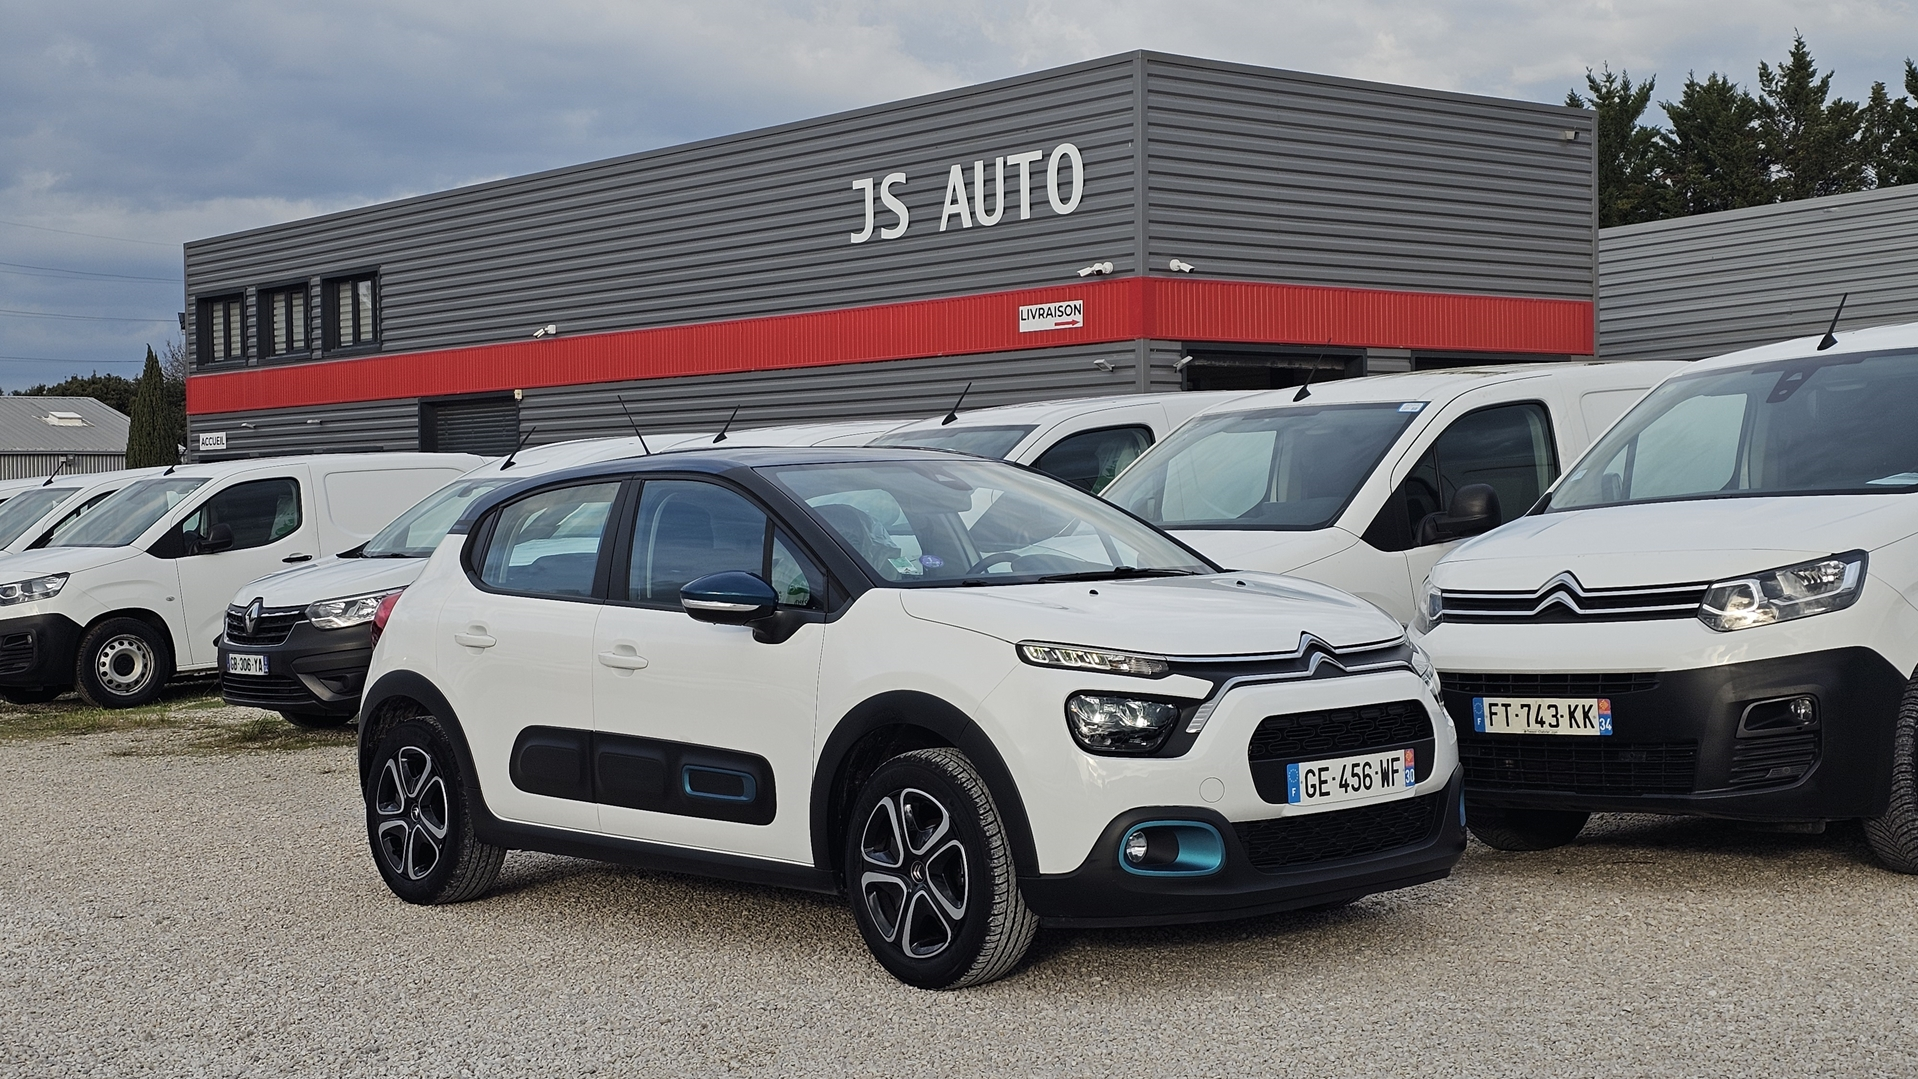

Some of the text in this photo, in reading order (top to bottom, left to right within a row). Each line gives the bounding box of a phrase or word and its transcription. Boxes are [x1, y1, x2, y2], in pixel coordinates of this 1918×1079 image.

[850, 142, 1084, 244] JS AUTO
[1020, 303, 1082, 321] LIVRAISON
[201, 436, 225, 446] ACCUEIL
[1600, 718, 1612, 731] 34
[1405, 769, 1415, 783] 30
